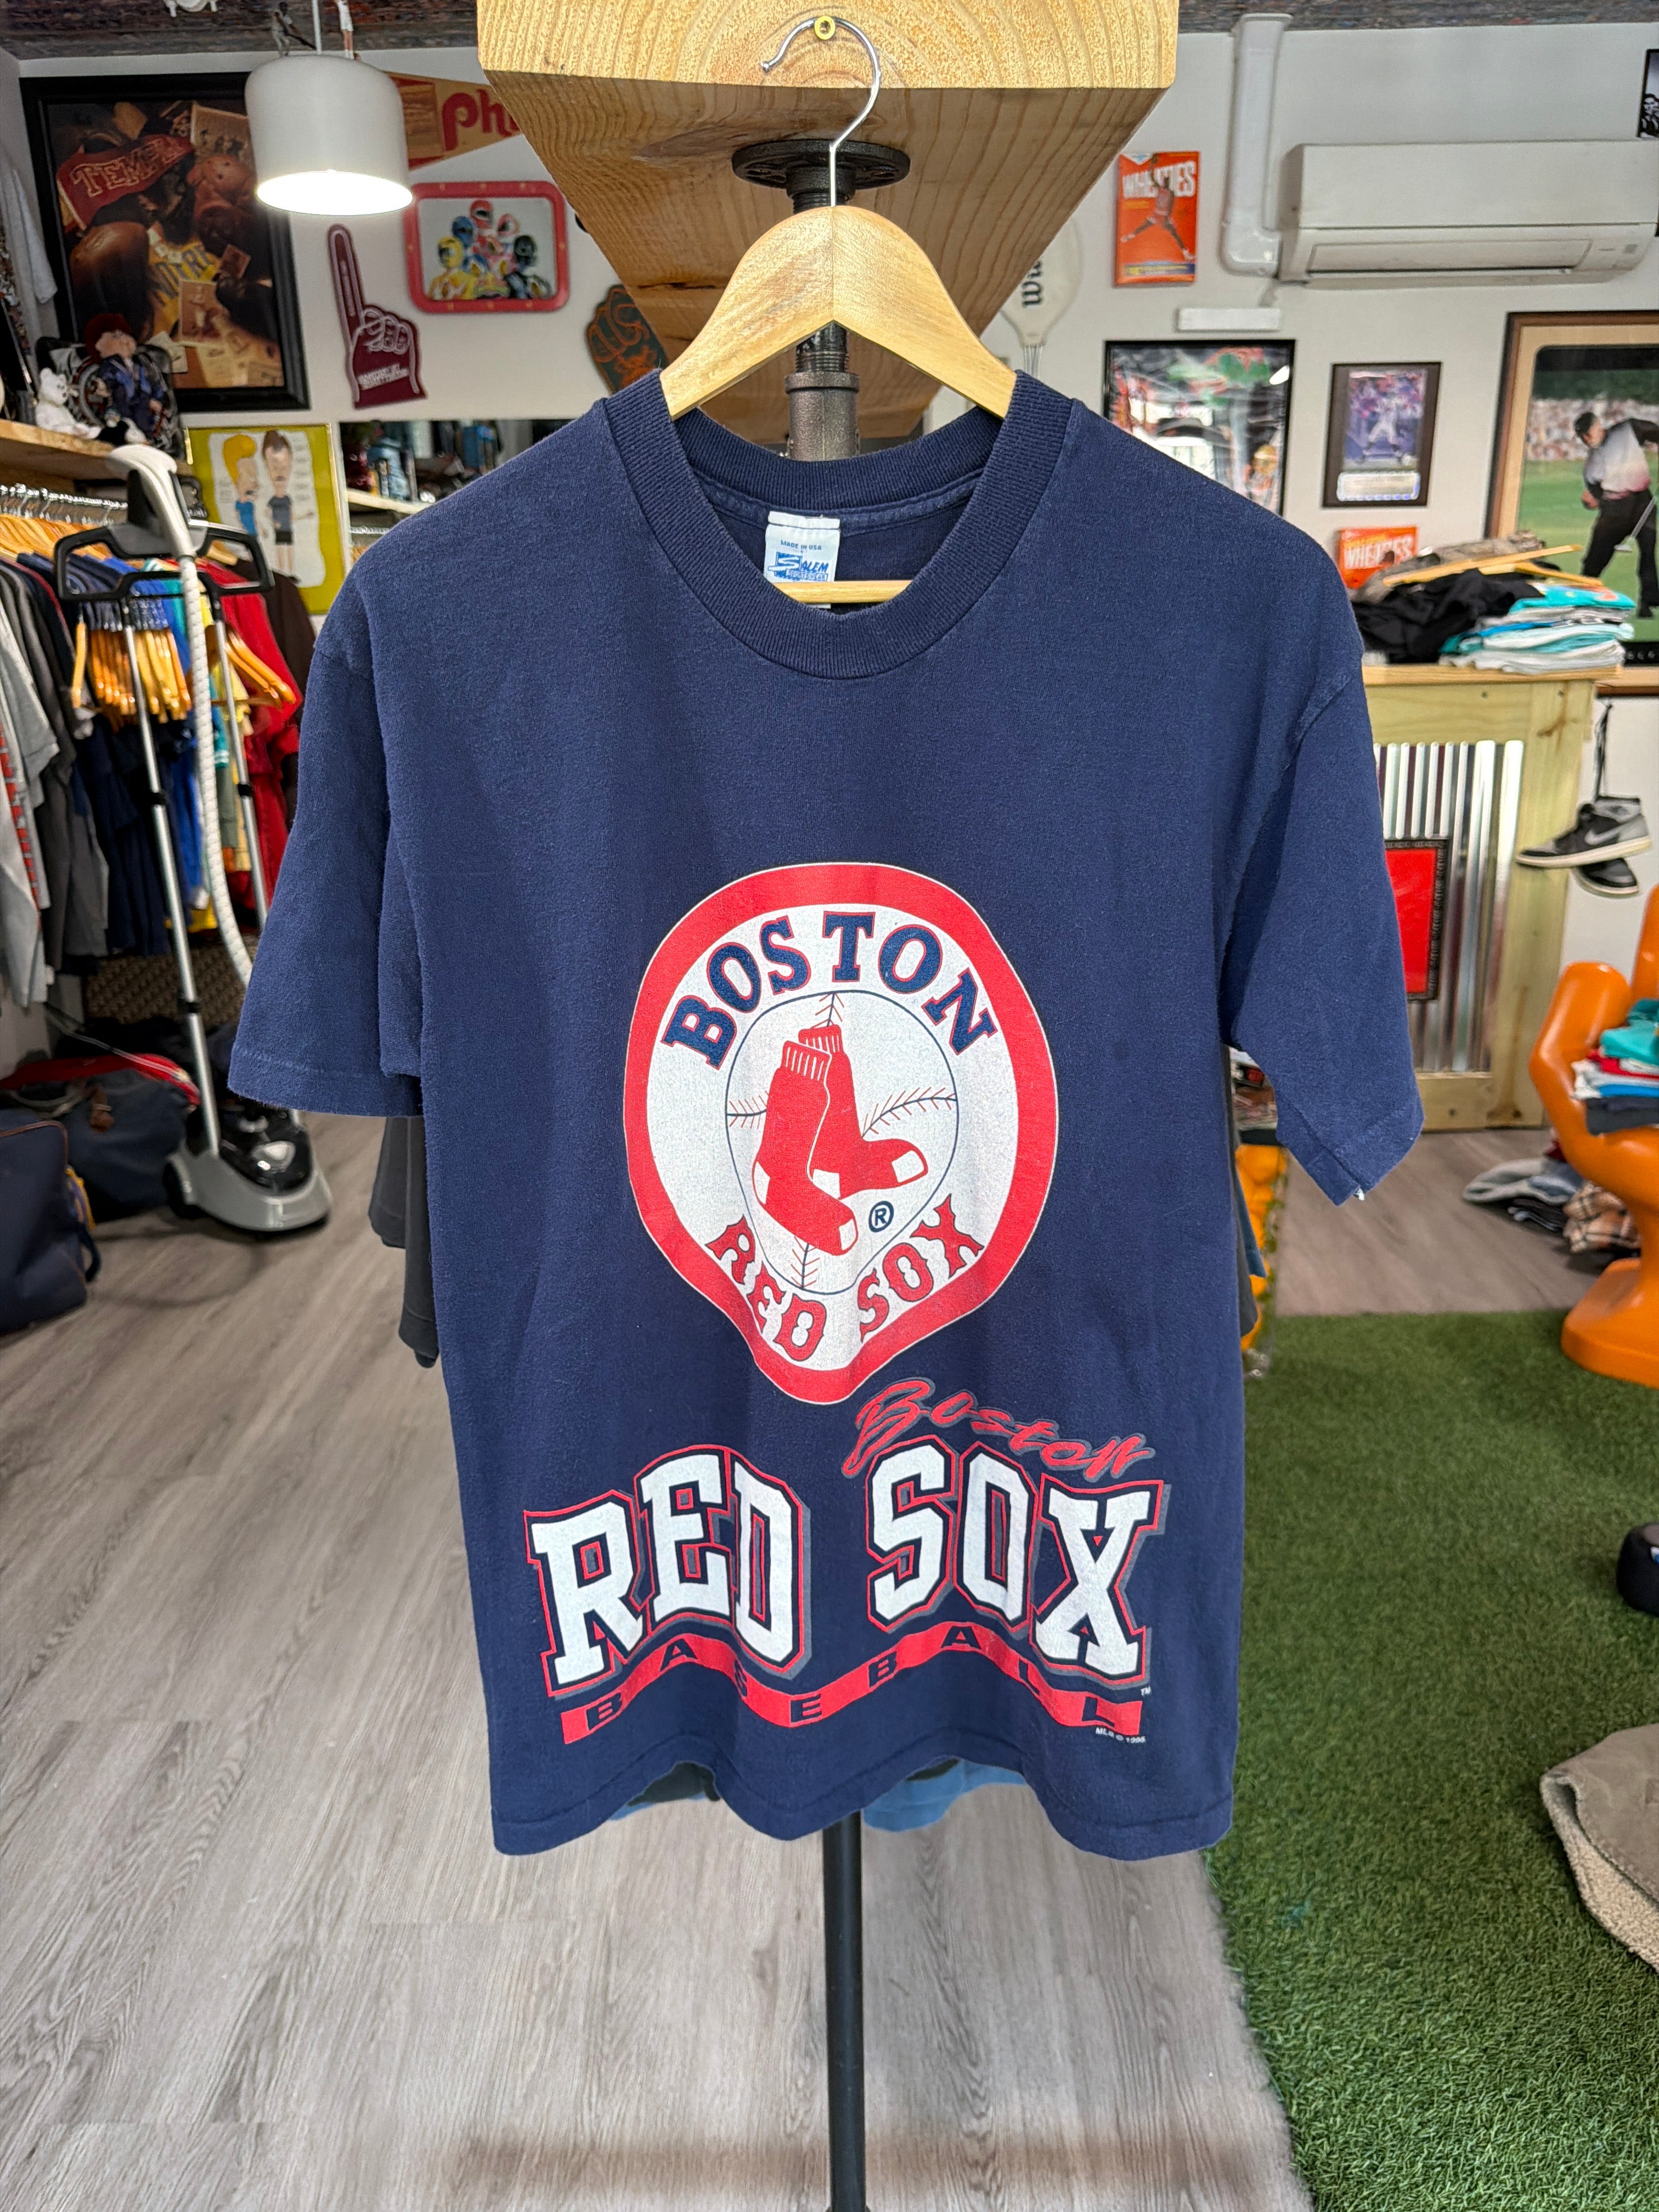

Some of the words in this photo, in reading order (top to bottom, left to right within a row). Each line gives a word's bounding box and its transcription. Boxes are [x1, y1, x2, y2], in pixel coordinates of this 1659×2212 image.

[780, 539, 799, 549] MADE
[661, 910, 997, 1070] BOSTON
[705, 1216, 827, 1362] RED
[857, 1193, 984, 1342] SOX
[842, 1378, 1155, 1480] Boston
[523, 1444, 808, 1697] RED
[866, 1435, 1167, 1686] SOX
[1096, 1727, 1114, 1738] MLB
